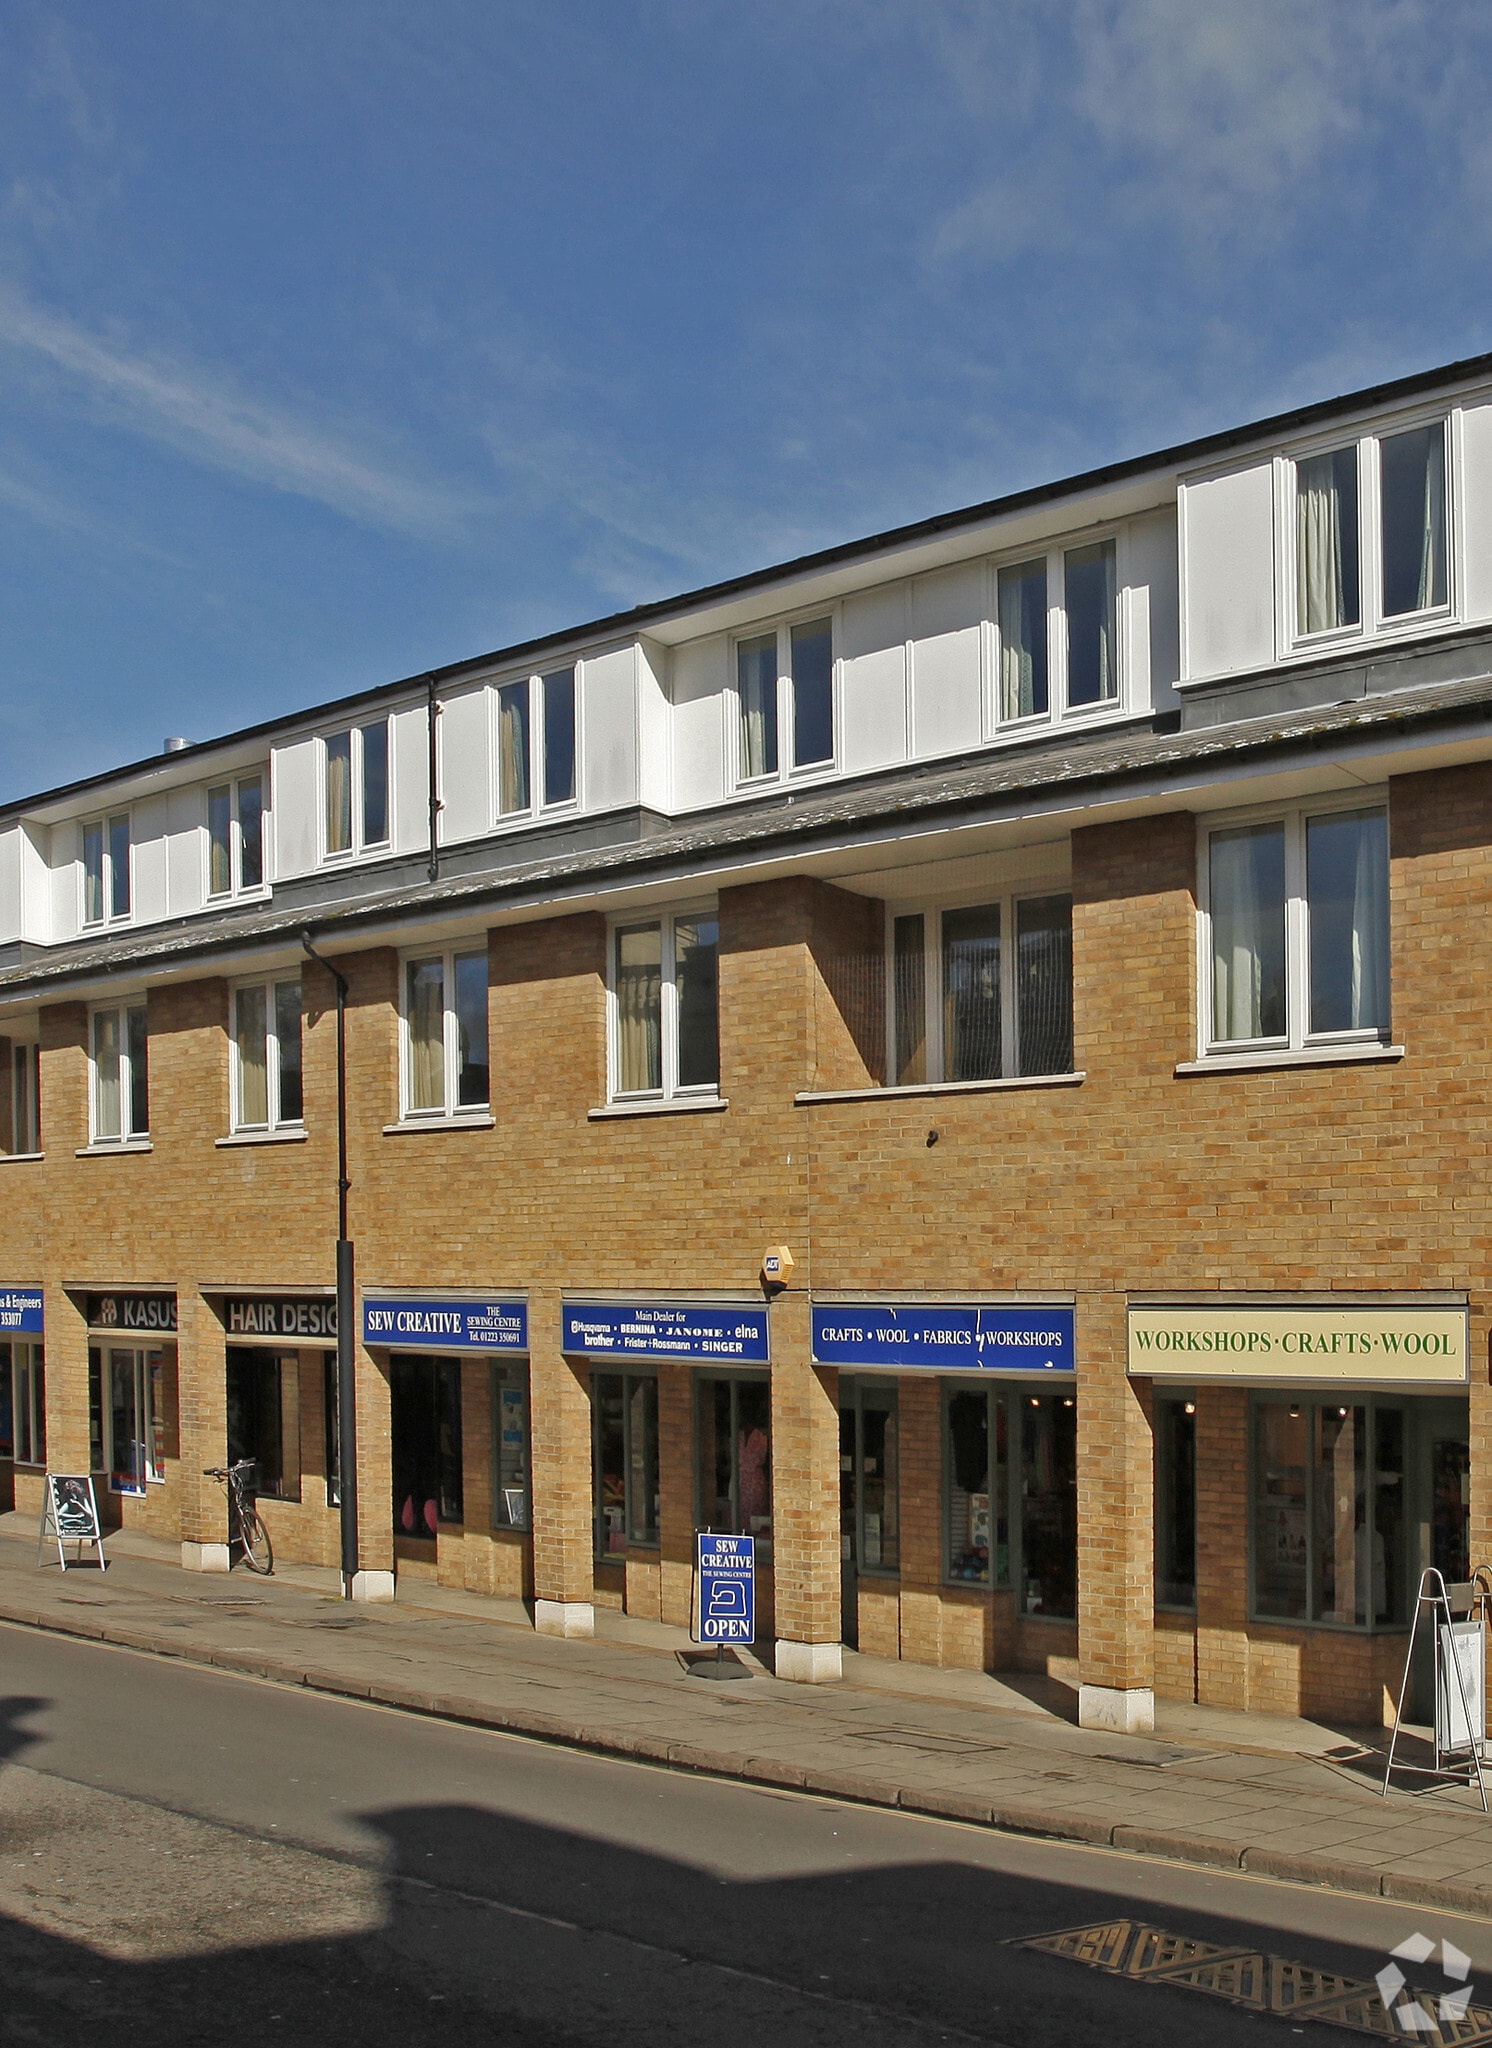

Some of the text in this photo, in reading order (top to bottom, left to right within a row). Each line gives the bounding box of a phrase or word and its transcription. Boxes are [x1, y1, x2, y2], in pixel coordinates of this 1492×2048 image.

[6, 1294, 11, 1308] &
[12, 1294, 42, 1312] Engineers
[486, 1306, 500, 1317] THE
[230, 1303, 338, 1335] HAIR DESIG
[367, 1310, 462, 1334] SEW CREATIVE
[466, 1315, 522, 1328] SEWING CENTRE
[635, 1310, 686, 1322] Main Dealer for
[480, 1332, 498, 1342] 01223
[620, 1323, 656, 1334] BERNINA
[665, 1327, 723, 1338] JANOME
[734, 1323, 759, 1339] elna
[821, 1327, 1063, 1347] CRAFTS WOOL FABRICS WORKSHOPS
[584, 1332, 615, 1347] brother
[701, 1340, 743, 1353] SINGER
[1135, 1330, 1457, 1356] WORKSHOPS CRAFTS WOOL
[715, 1540, 738, 1553] SEW
[701, 1554, 753, 1569] CREATIVE
[704, 1619, 750, 1637] OPEN
